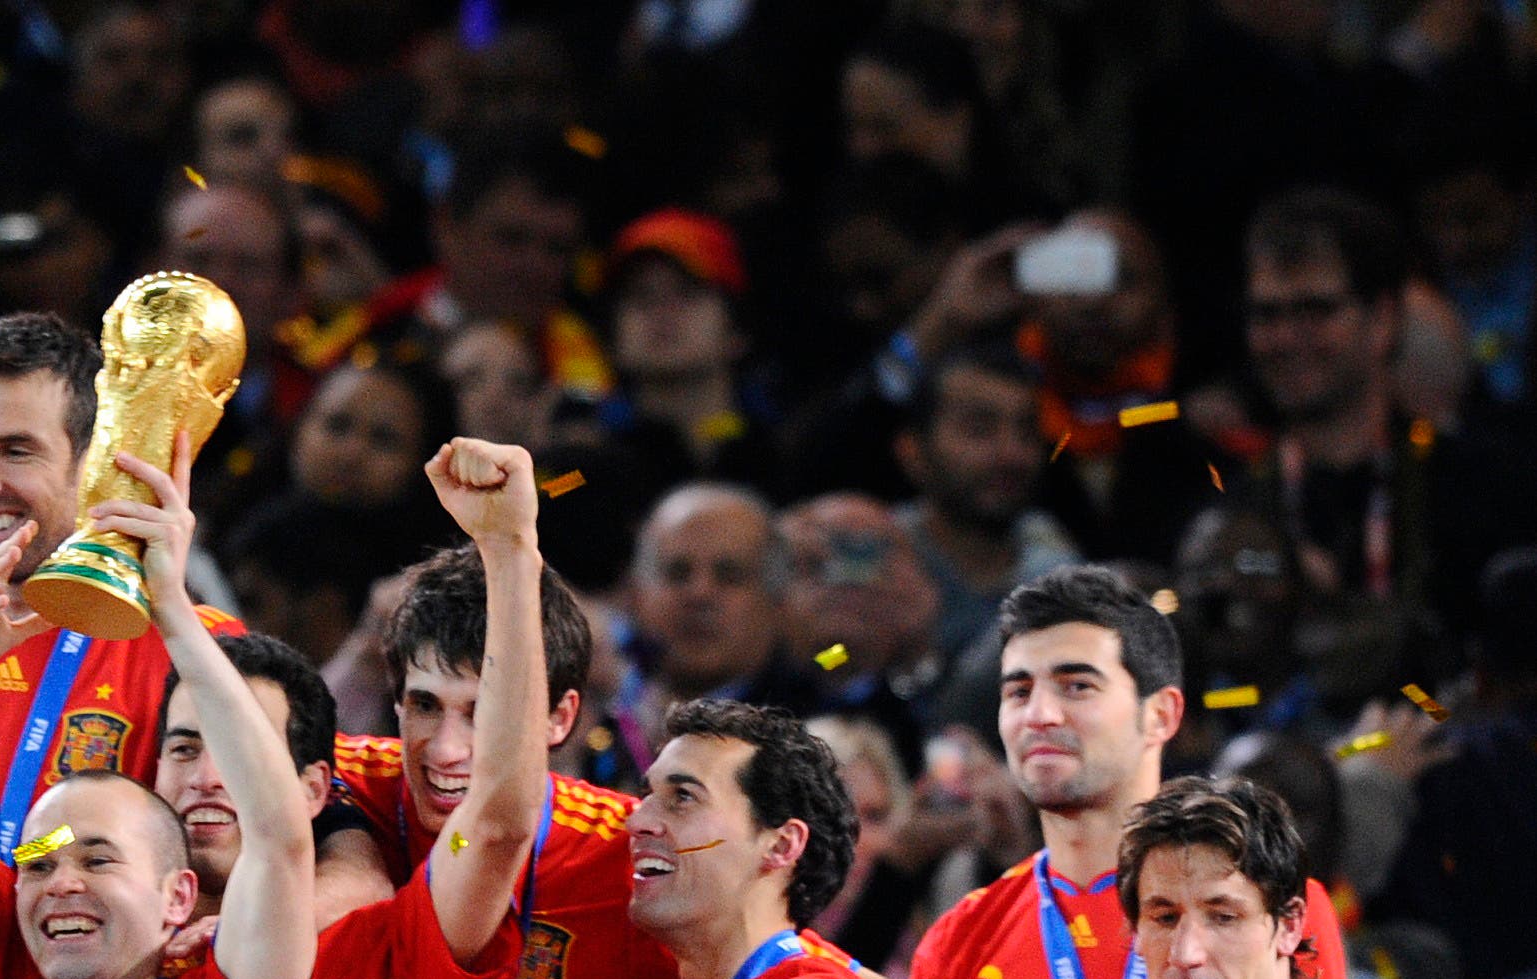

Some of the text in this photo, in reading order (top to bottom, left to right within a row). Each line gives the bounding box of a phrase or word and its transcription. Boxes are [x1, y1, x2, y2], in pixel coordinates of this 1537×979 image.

[61, 631, 84, 653] IFA
[24, 718, 49, 751] FIFA
[0, 821, 16, 854] FIFA
